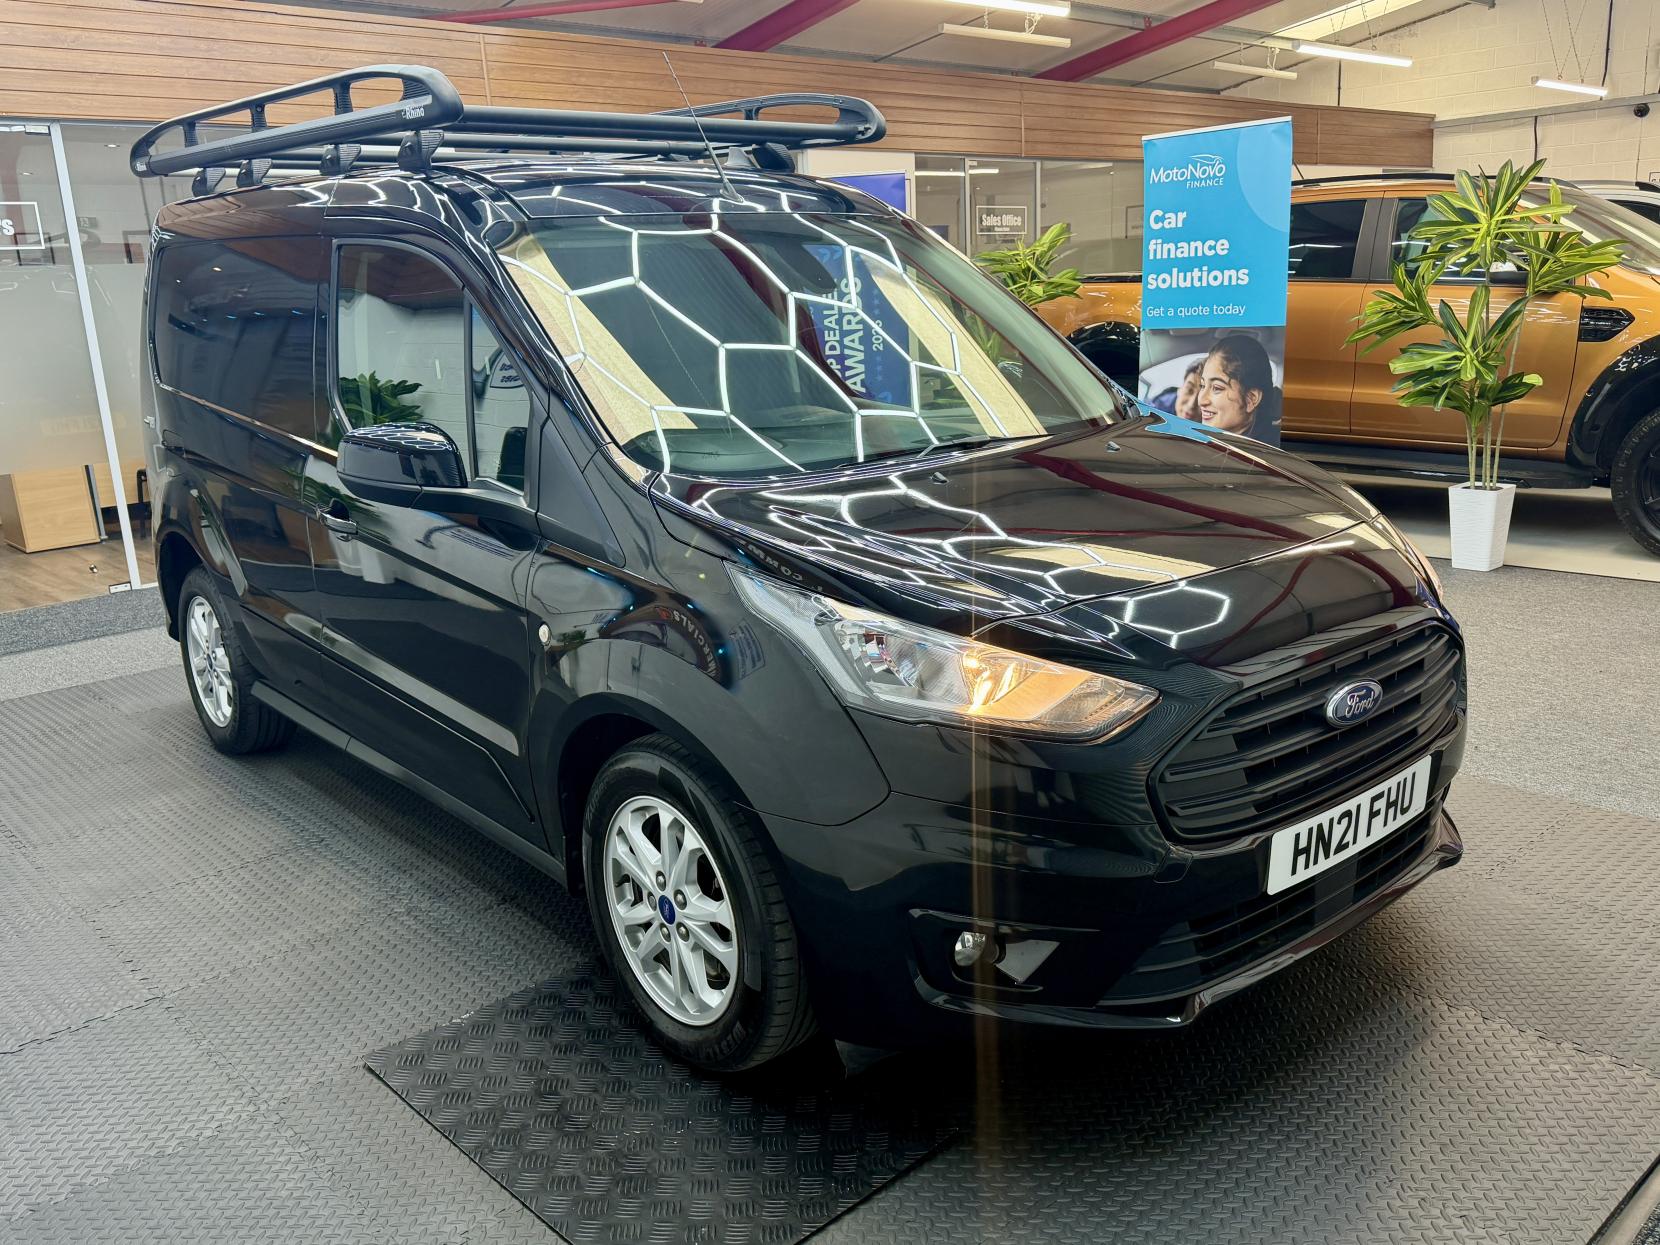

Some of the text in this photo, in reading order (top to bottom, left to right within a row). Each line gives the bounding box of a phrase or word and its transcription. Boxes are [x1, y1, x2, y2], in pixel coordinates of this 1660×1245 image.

[1150, 160, 1226, 184] MotoNovo
[1186, 178, 1224, 189] FINANCE
[982, 214, 1022, 226] Sales Office
[1149, 209, 1187, 230] Car
[1148, 238, 1230, 260] finance
[1147, 266, 1250, 289] solutions
[824, 277, 841, 356] DEALE
[1146, 303, 1246, 317] Get a quote today
[840, 276, 866, 393] AWARDS
[1345, 689, 1375, 718] Ford
[1290, 771, 1416, 877] HN21 FHU
